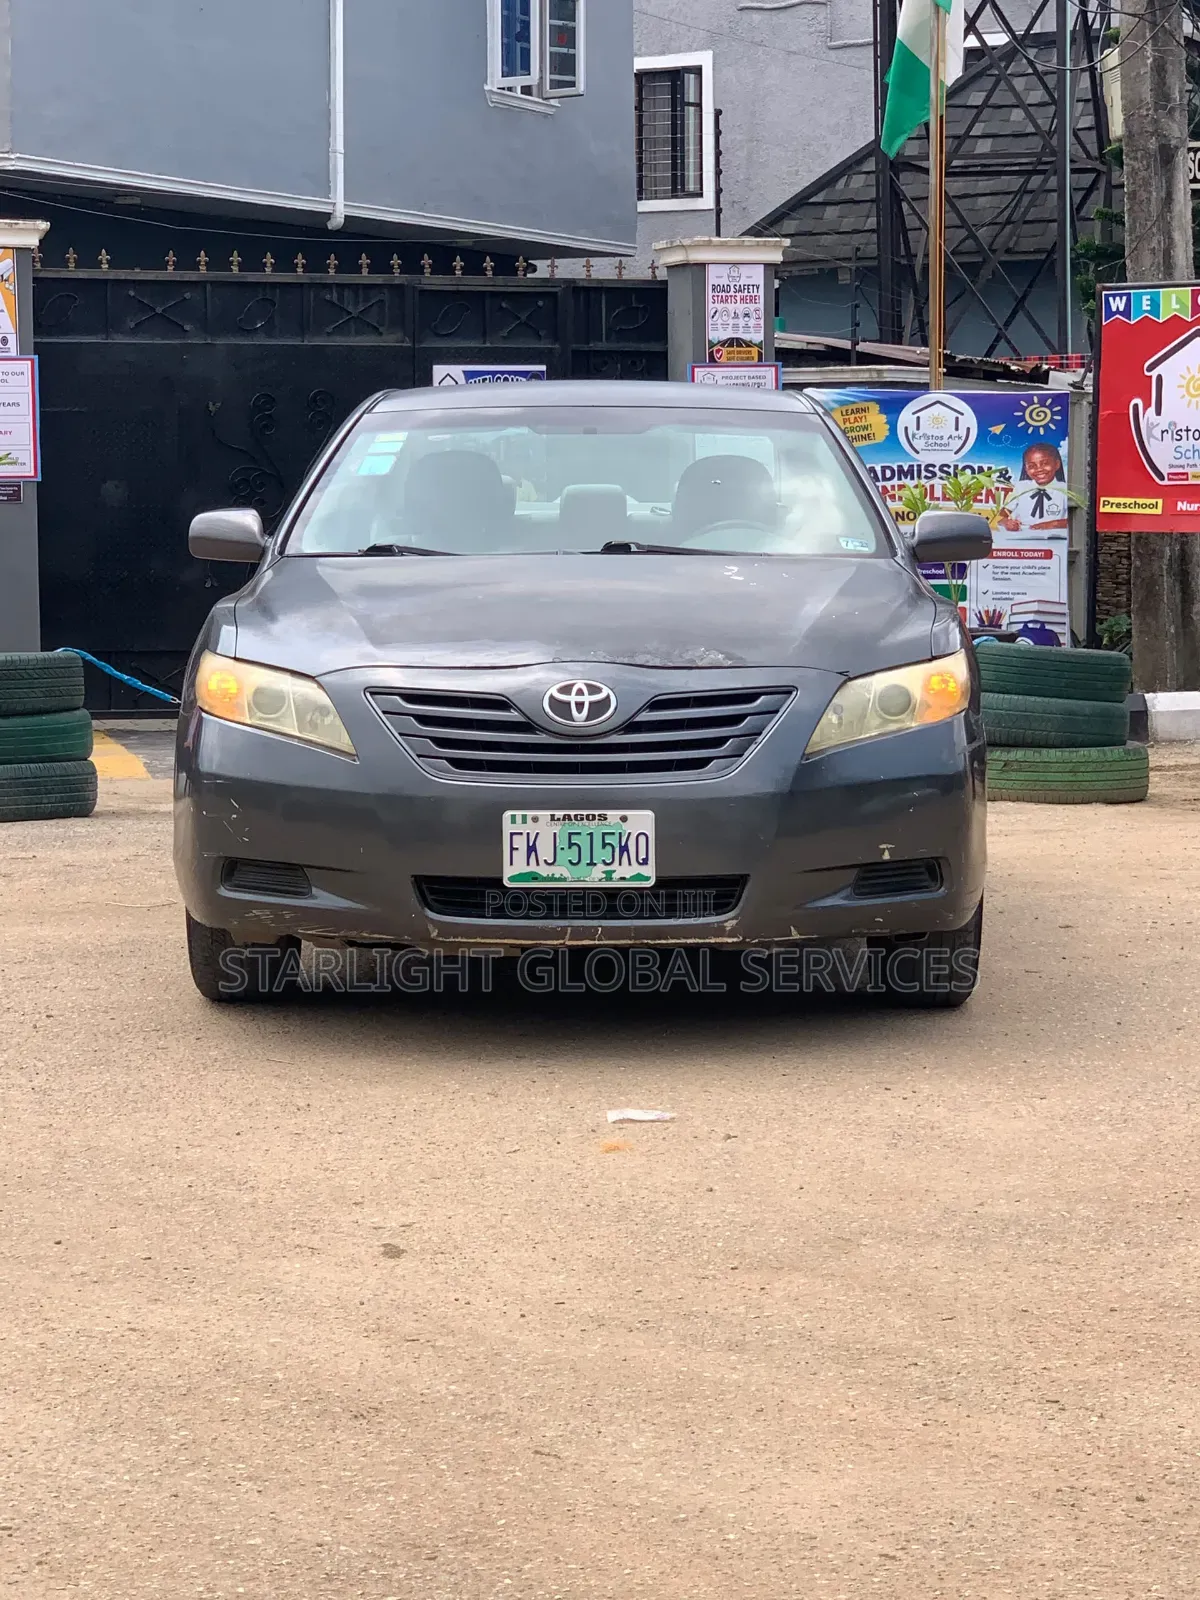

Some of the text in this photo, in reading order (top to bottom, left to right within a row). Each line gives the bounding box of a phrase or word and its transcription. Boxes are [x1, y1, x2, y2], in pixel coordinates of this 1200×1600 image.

[711, 284, 760, 293] ROAD SAFETY
[711, 295, 760, 304] STARTS HERE!
[1108, 294, 1200, 312] WEL
[840, 406, 870, 417] LEARN!
[842, 415, 867, 425] PLAY!
[844, 424, 873, 434] GROW!
[1102, 500, 1159, 509] Preschool
[550, 813, 608, 821] LAGOS
